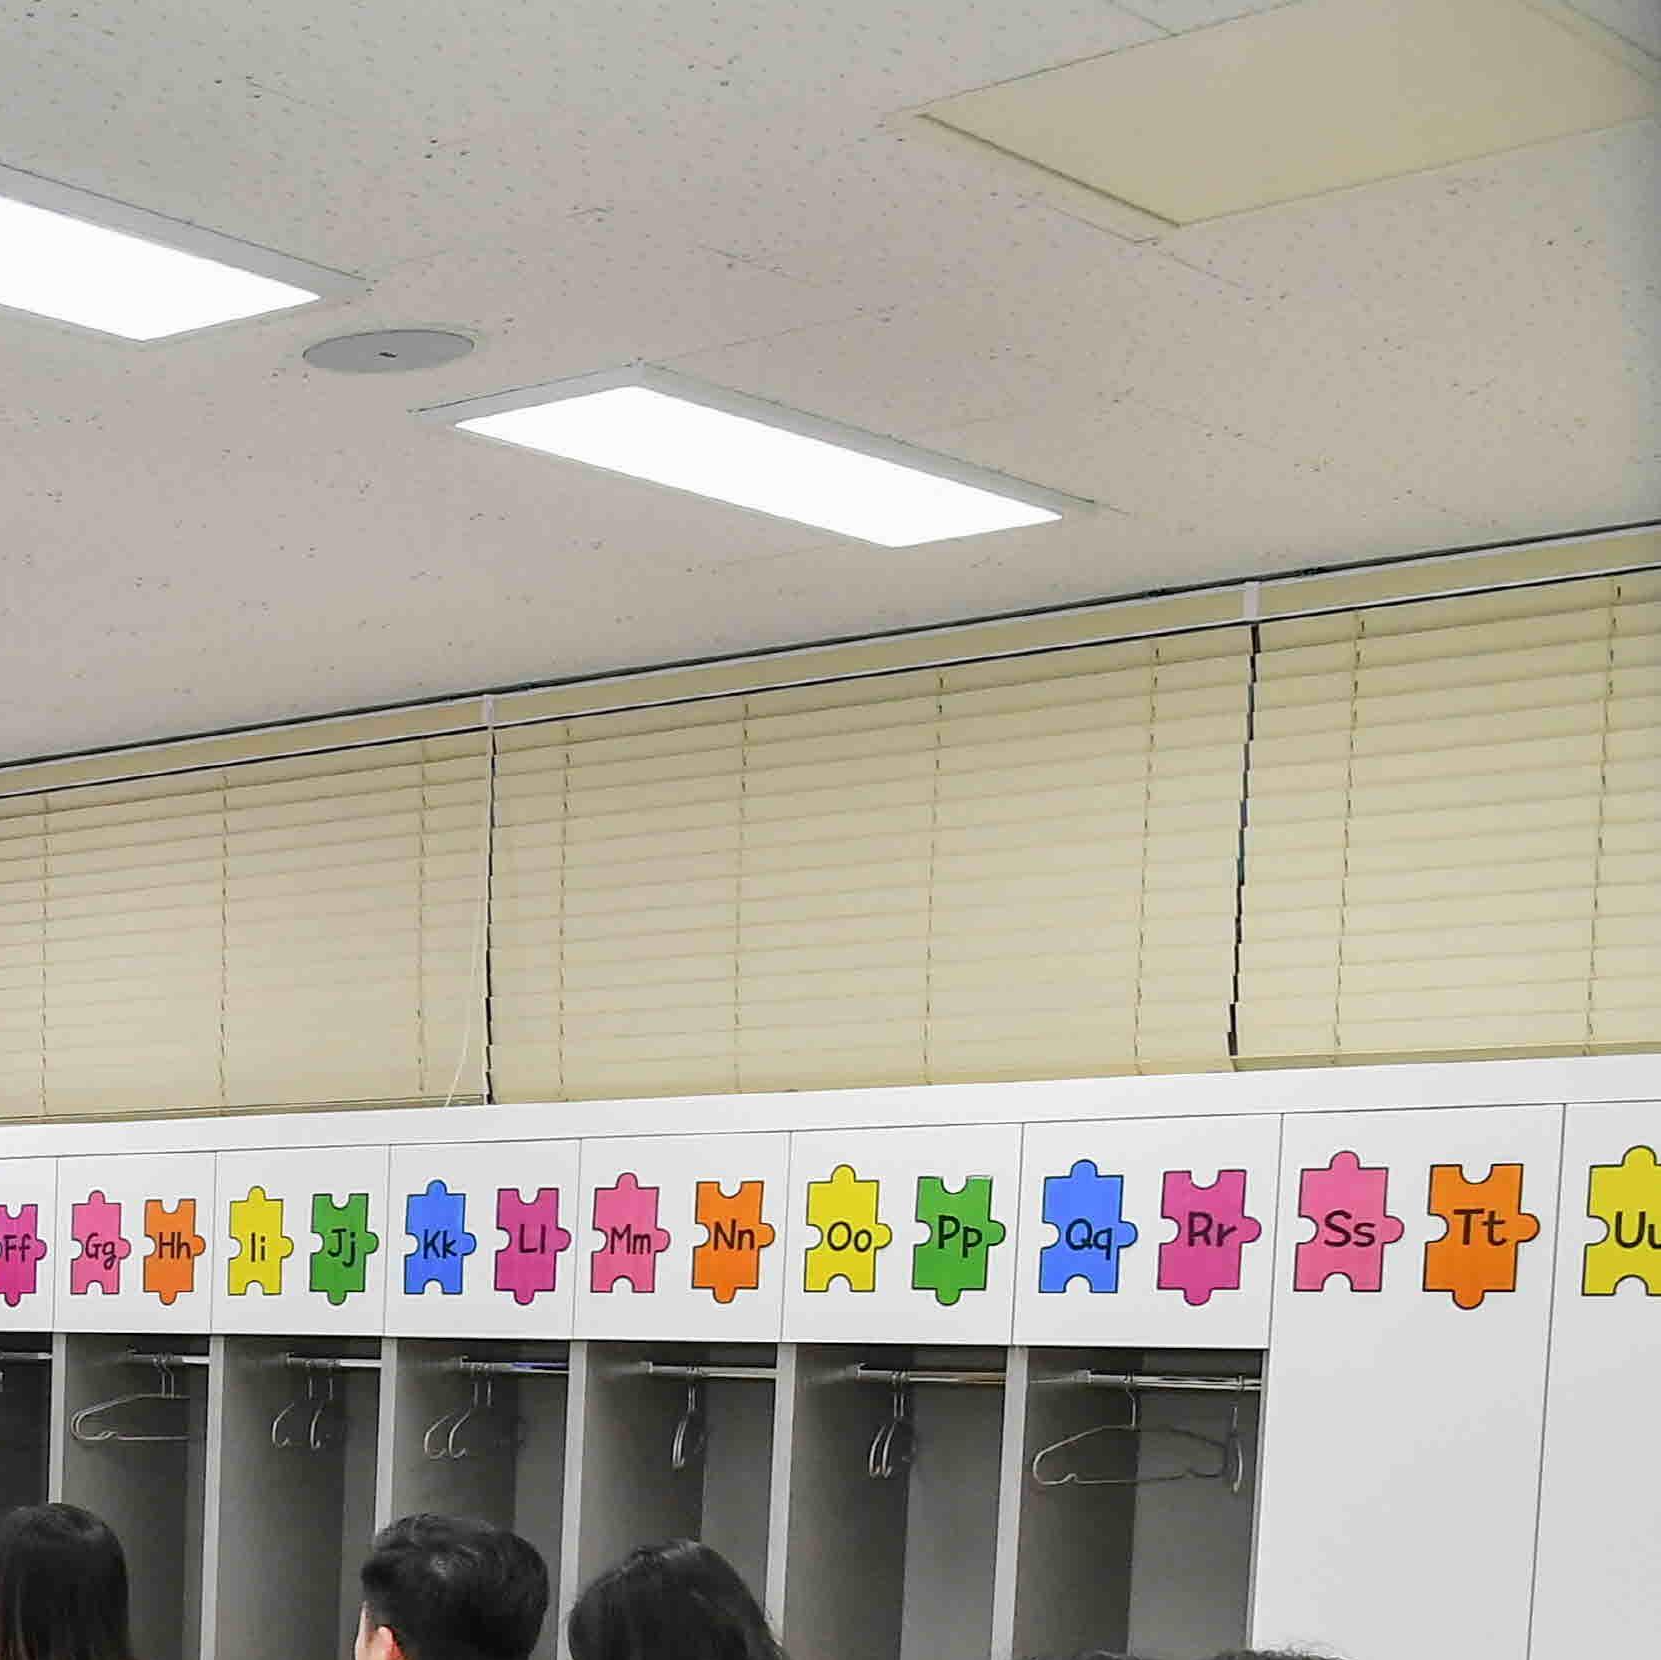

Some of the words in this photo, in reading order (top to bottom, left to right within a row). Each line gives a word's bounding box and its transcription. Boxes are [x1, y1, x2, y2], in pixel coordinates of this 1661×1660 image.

[3, 1235, 32, 1261] Ff
[84, 1237, 118, 1269] Gg
[157, 1234, 192, 1259] Hh
[327, 1231, 356, 1267] Jj
[422, 1231, 457, 1258] Kk
[519, 1224, 546, 1254] Ll
[609, 1223, 652, 1255] Mm
[713, 1217, 756, 1251] Nn
[826, 1222, 874, 1253] Oo
[936, 1214, 982, 1259] Pp
[1064, 1218, 1113, 1261] Qq
[1187, 1212, 1237, 1247] Rr
[1323, 1210, 1376, 1248] Ss
[1453, 1208, 1507, 1247] Tt
[1615, 1211, 1661, 1249] Uu
